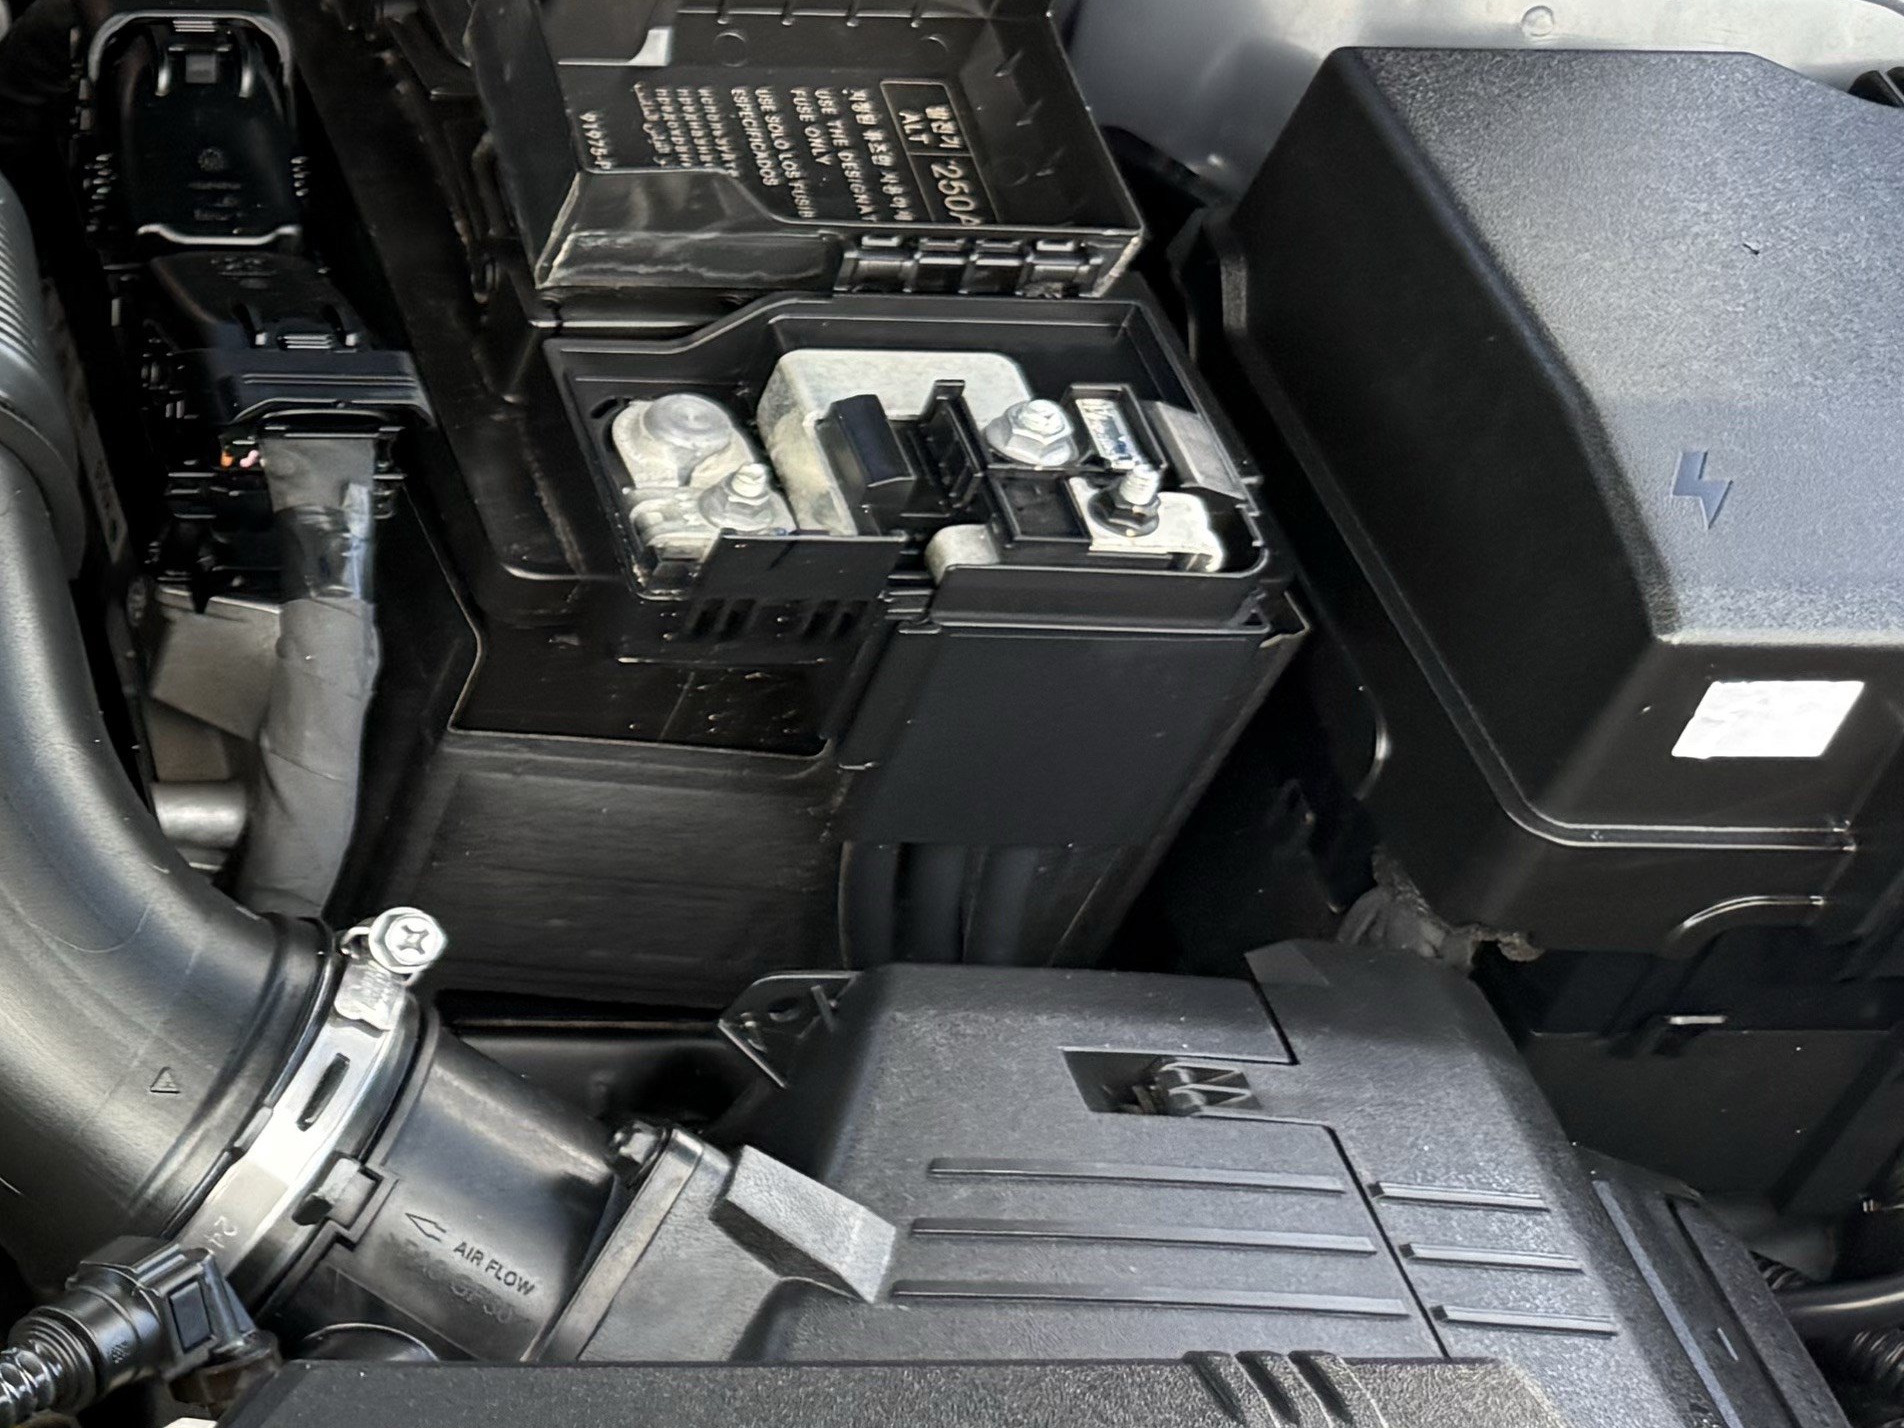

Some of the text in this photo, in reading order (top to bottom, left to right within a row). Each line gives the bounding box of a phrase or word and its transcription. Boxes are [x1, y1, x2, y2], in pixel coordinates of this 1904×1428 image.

[755, 87, 776, 113] USE
[790, 87, 833, 166] FUSE ONLY
[898, 111, 930, 144] ALT
[579, 111, 611, 171] 91975-P
[731, 87, 779, 187] ESPECIFICADOS
[765, 113, 789, 150] SOLO
[813, 88, 877, 223] USE THE DESIGNAT
[778, 151, 800, 180] LOS
[453, 1240, 536, 1296] AIR FLOW
